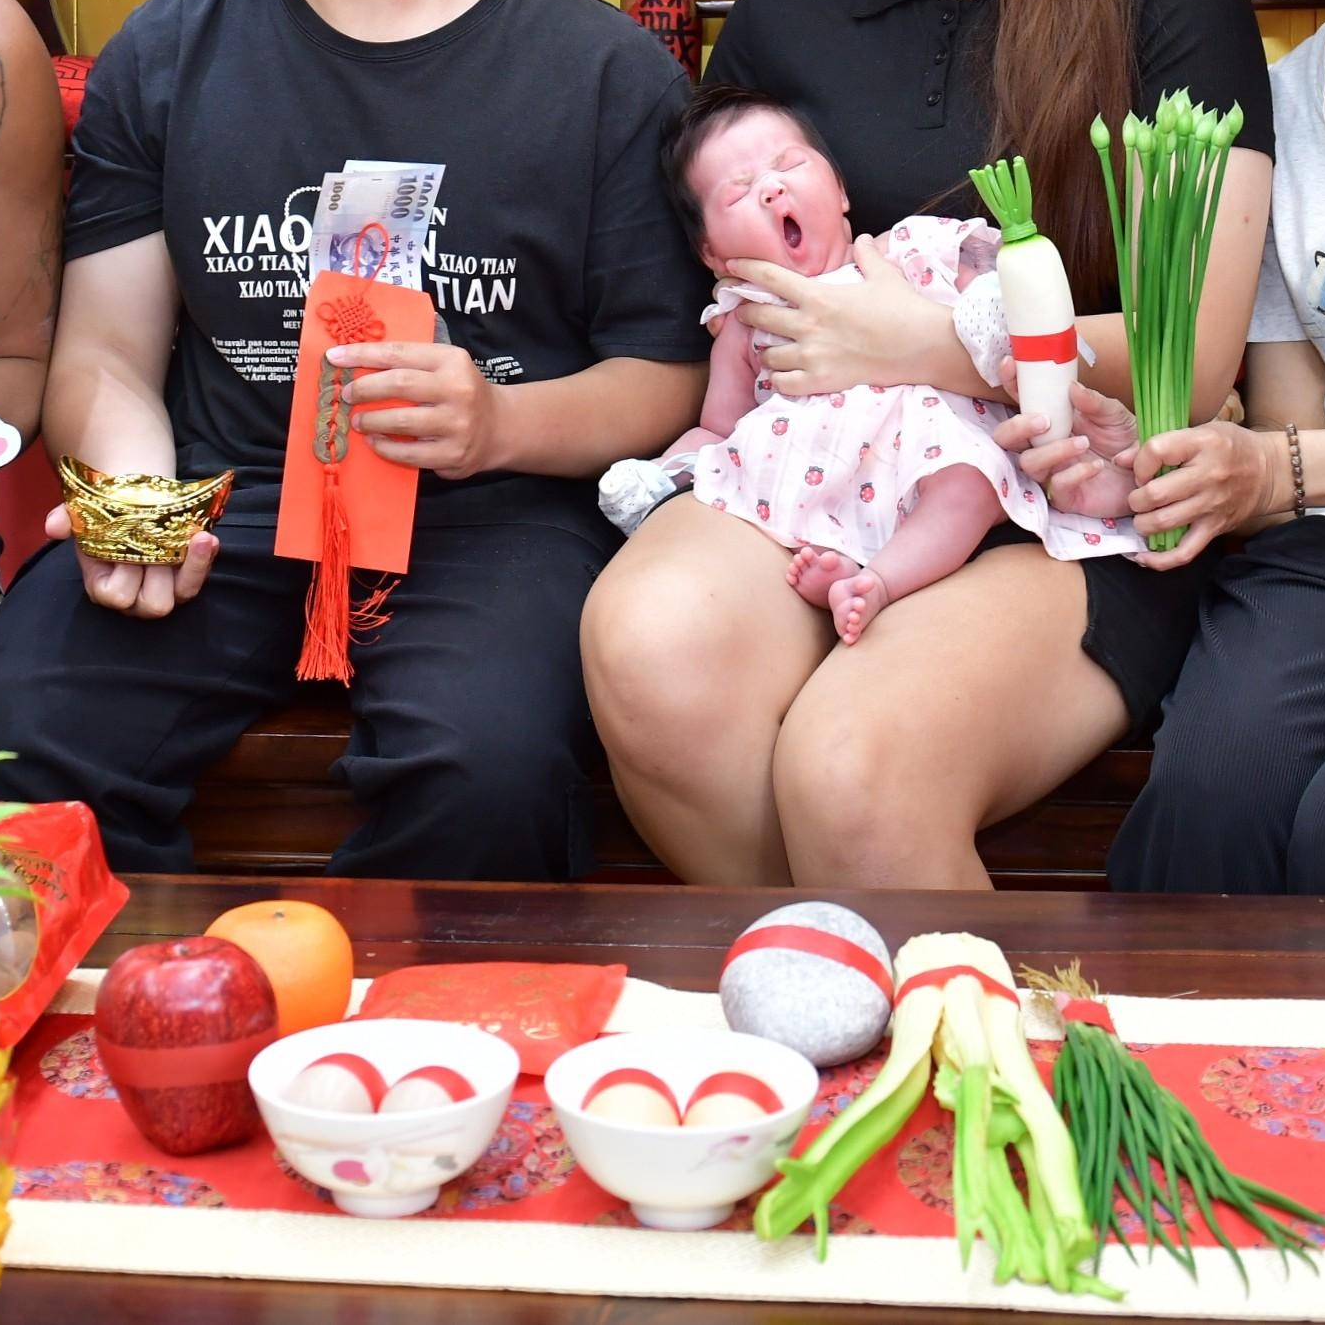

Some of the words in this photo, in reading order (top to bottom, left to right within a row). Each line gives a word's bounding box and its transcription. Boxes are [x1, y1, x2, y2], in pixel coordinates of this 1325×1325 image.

[328, 181, 345, 211] 1000
[391, 176, 418, 219] 1000
[202, 214, 313, 254] XIAO
[205, 255, 254, 272] XIAO
[258, 255, 308, 271] TIAN
[439, 253, 477, 274] XIAO
[481, 258, 517, 275] TIAN
[238, 280, 274, 298] XIAO
[276, 280, 310, 298] TIAN
[429, 274, 517, 315] TIAN
[283, 309, 298, 318] JOIN
[283, 321, 301, 329] MEET
[248, 339, 262, 350] pas
[263, 339, 279, 347] son
